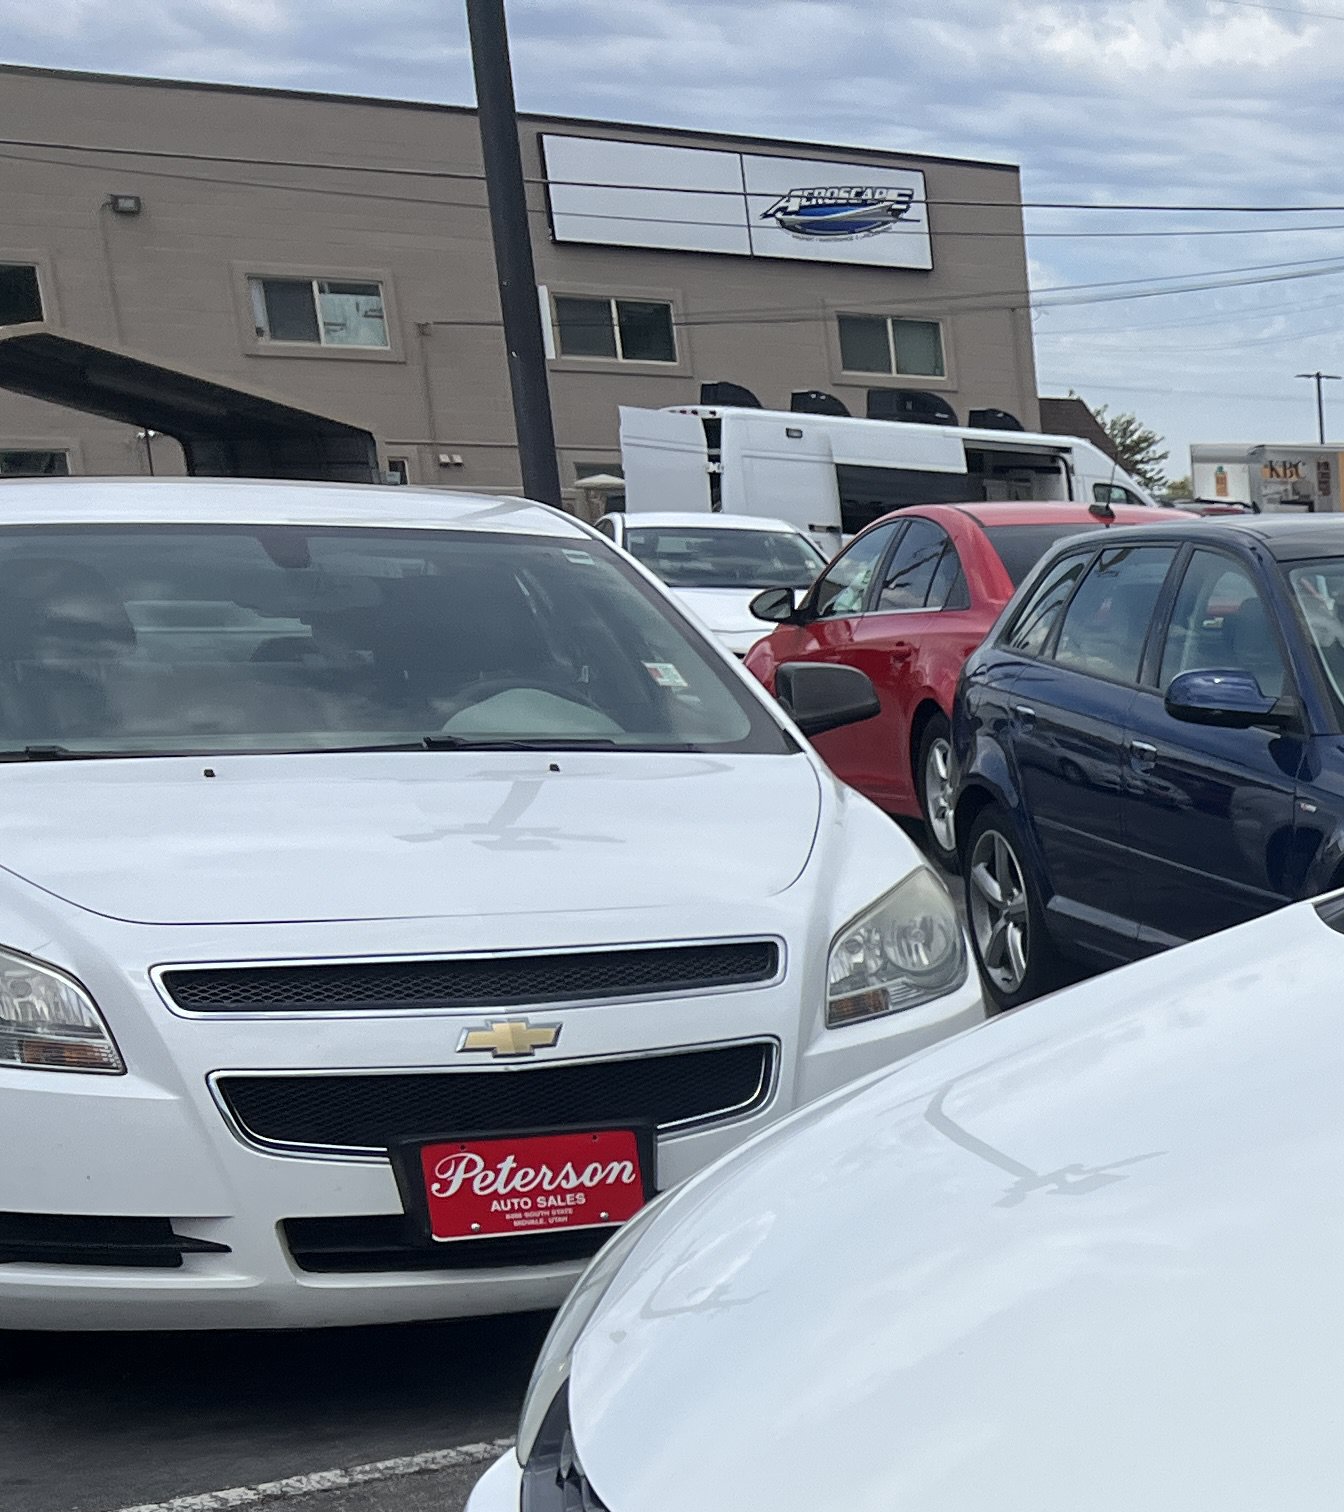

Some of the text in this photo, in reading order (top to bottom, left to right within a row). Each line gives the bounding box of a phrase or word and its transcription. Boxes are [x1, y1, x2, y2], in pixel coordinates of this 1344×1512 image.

[431, 1152, 636, 1197] Peterson
[490, 1192, 586, 1212] AUTO SALES
